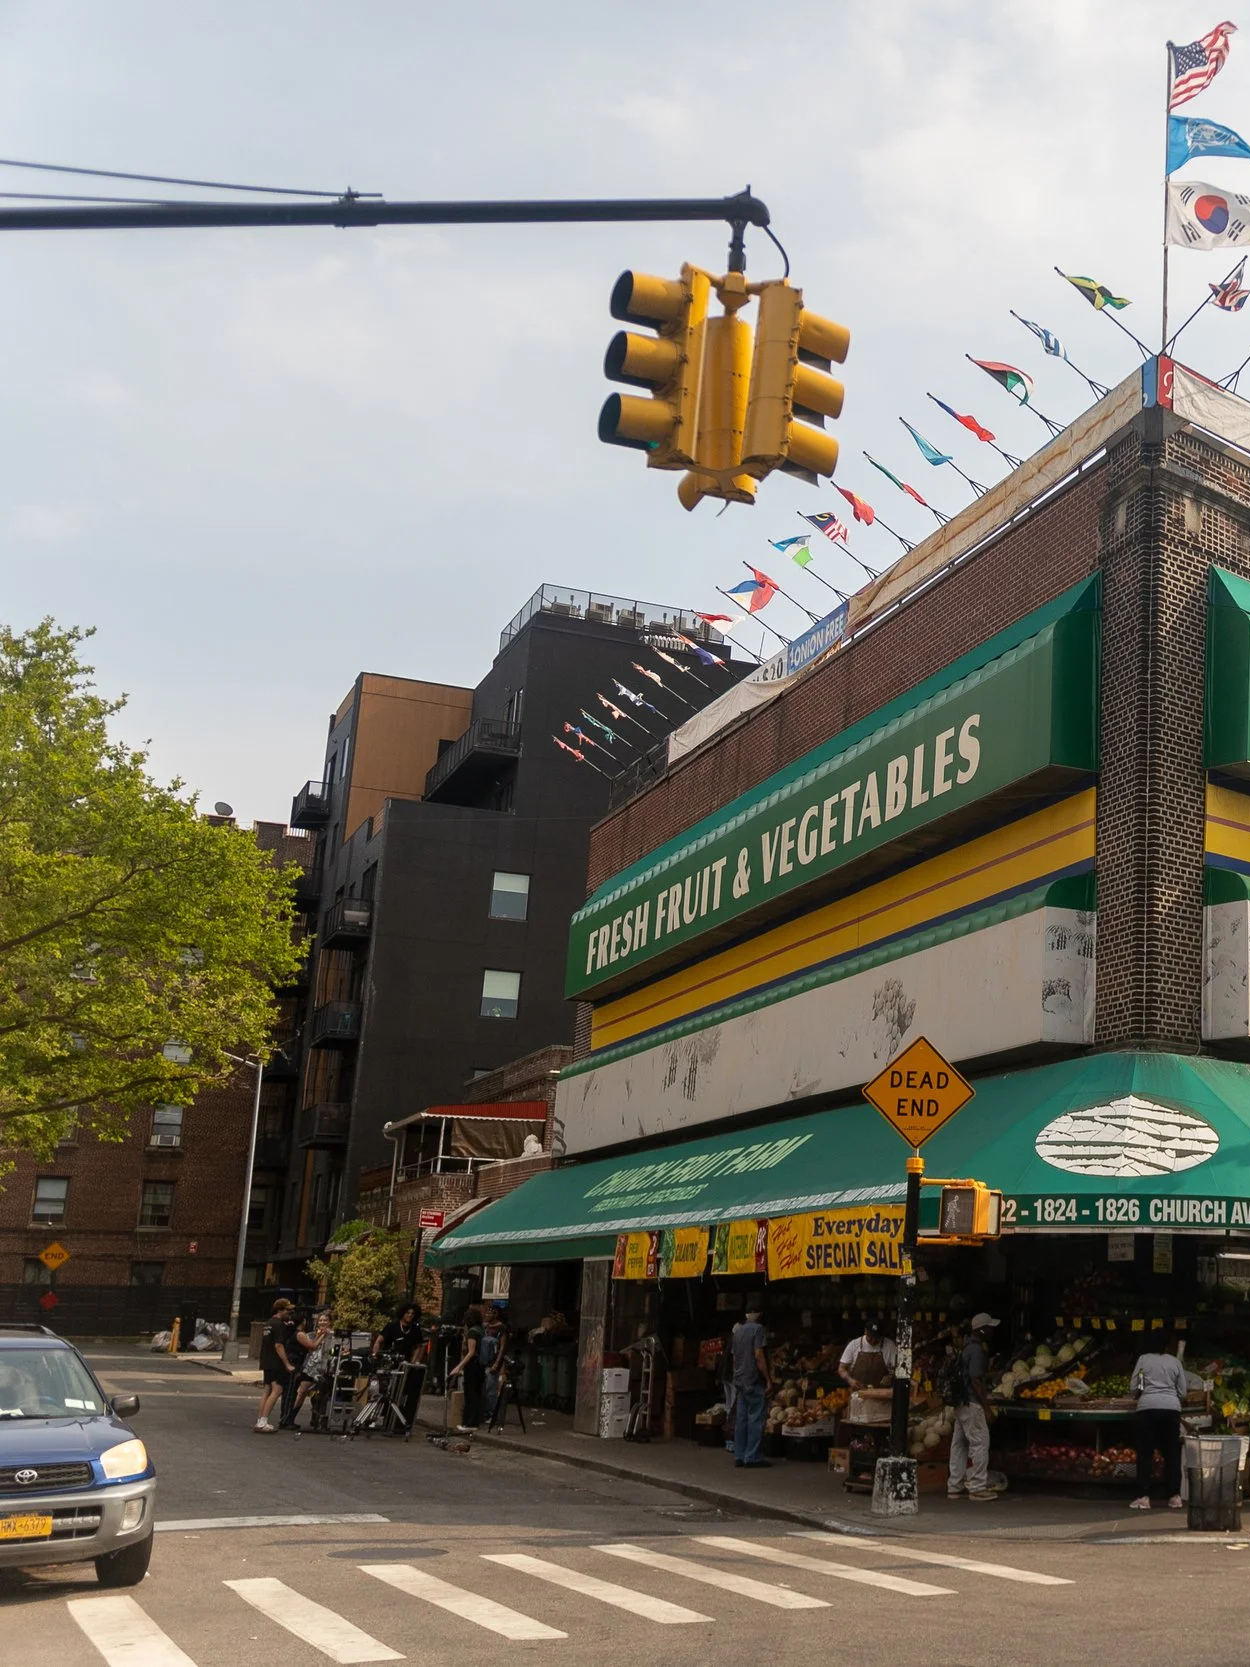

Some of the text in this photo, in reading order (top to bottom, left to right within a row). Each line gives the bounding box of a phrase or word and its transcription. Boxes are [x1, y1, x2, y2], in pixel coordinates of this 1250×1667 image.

[794, 630, 824, 666] ONION
[825, 613, 845, 643] FREE
[586, 713, 981, 976] FRESH FRUIT & VEGETABLES
[890, 1070, 949, 1090] DEAD
[896, 1098, 939, 1117] END
[648, 1146, 746, 1186] FRUIT
[722, 1133, 815, 1176] FARM
[1034, 1198, 1077, 1222] 1824
[1095, 1198, 1141, 1222] 1826
[1150, 1199, 1227, 1224] CHURCH
[772, 1219, 793, 1244] Hot
[812, 1212, 905, 1239] Everyday
[44, 1252, 65, 1260] END
[776, 1234, 798, 1259] Hot
[780, 1249, 802, 1273] Hot
